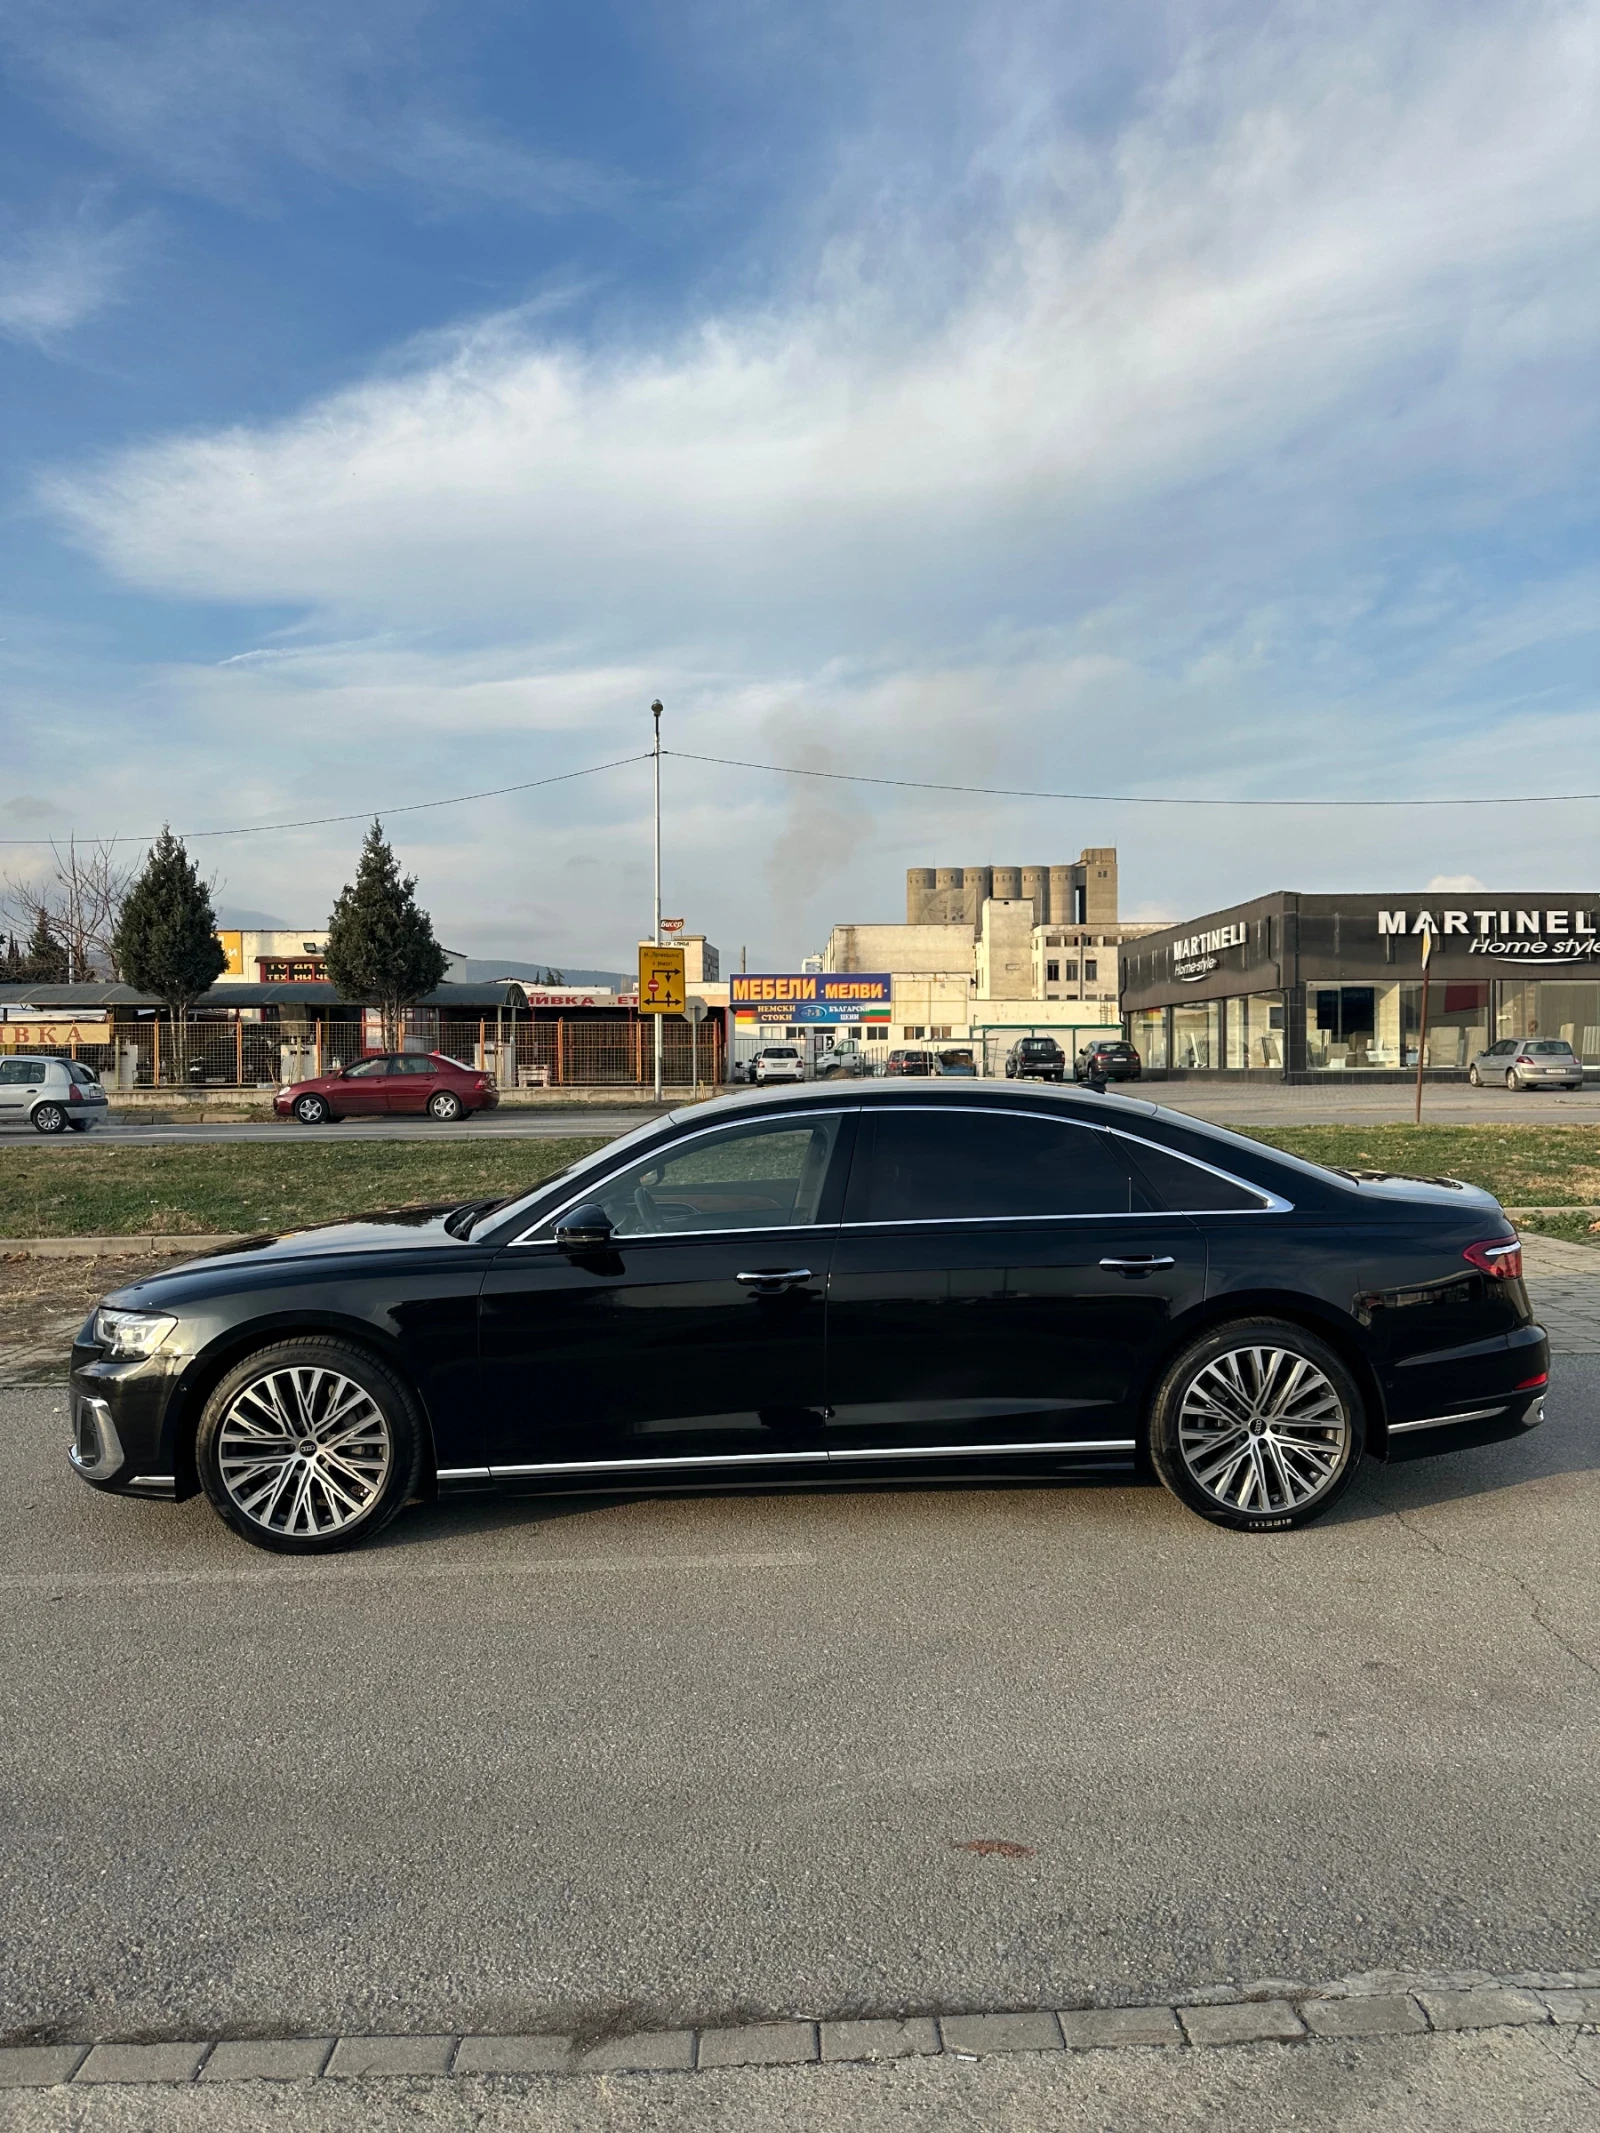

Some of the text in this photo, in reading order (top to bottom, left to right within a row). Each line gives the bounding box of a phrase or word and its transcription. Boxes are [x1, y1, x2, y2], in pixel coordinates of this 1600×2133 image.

[1174, 921, 1247, 961] MARTINELI
[1469, 938, 1600, 956] Home style
[1174, 957, 1217, 976] Home style
[733, 977, 816, 1000] МЕБЕЛИ
